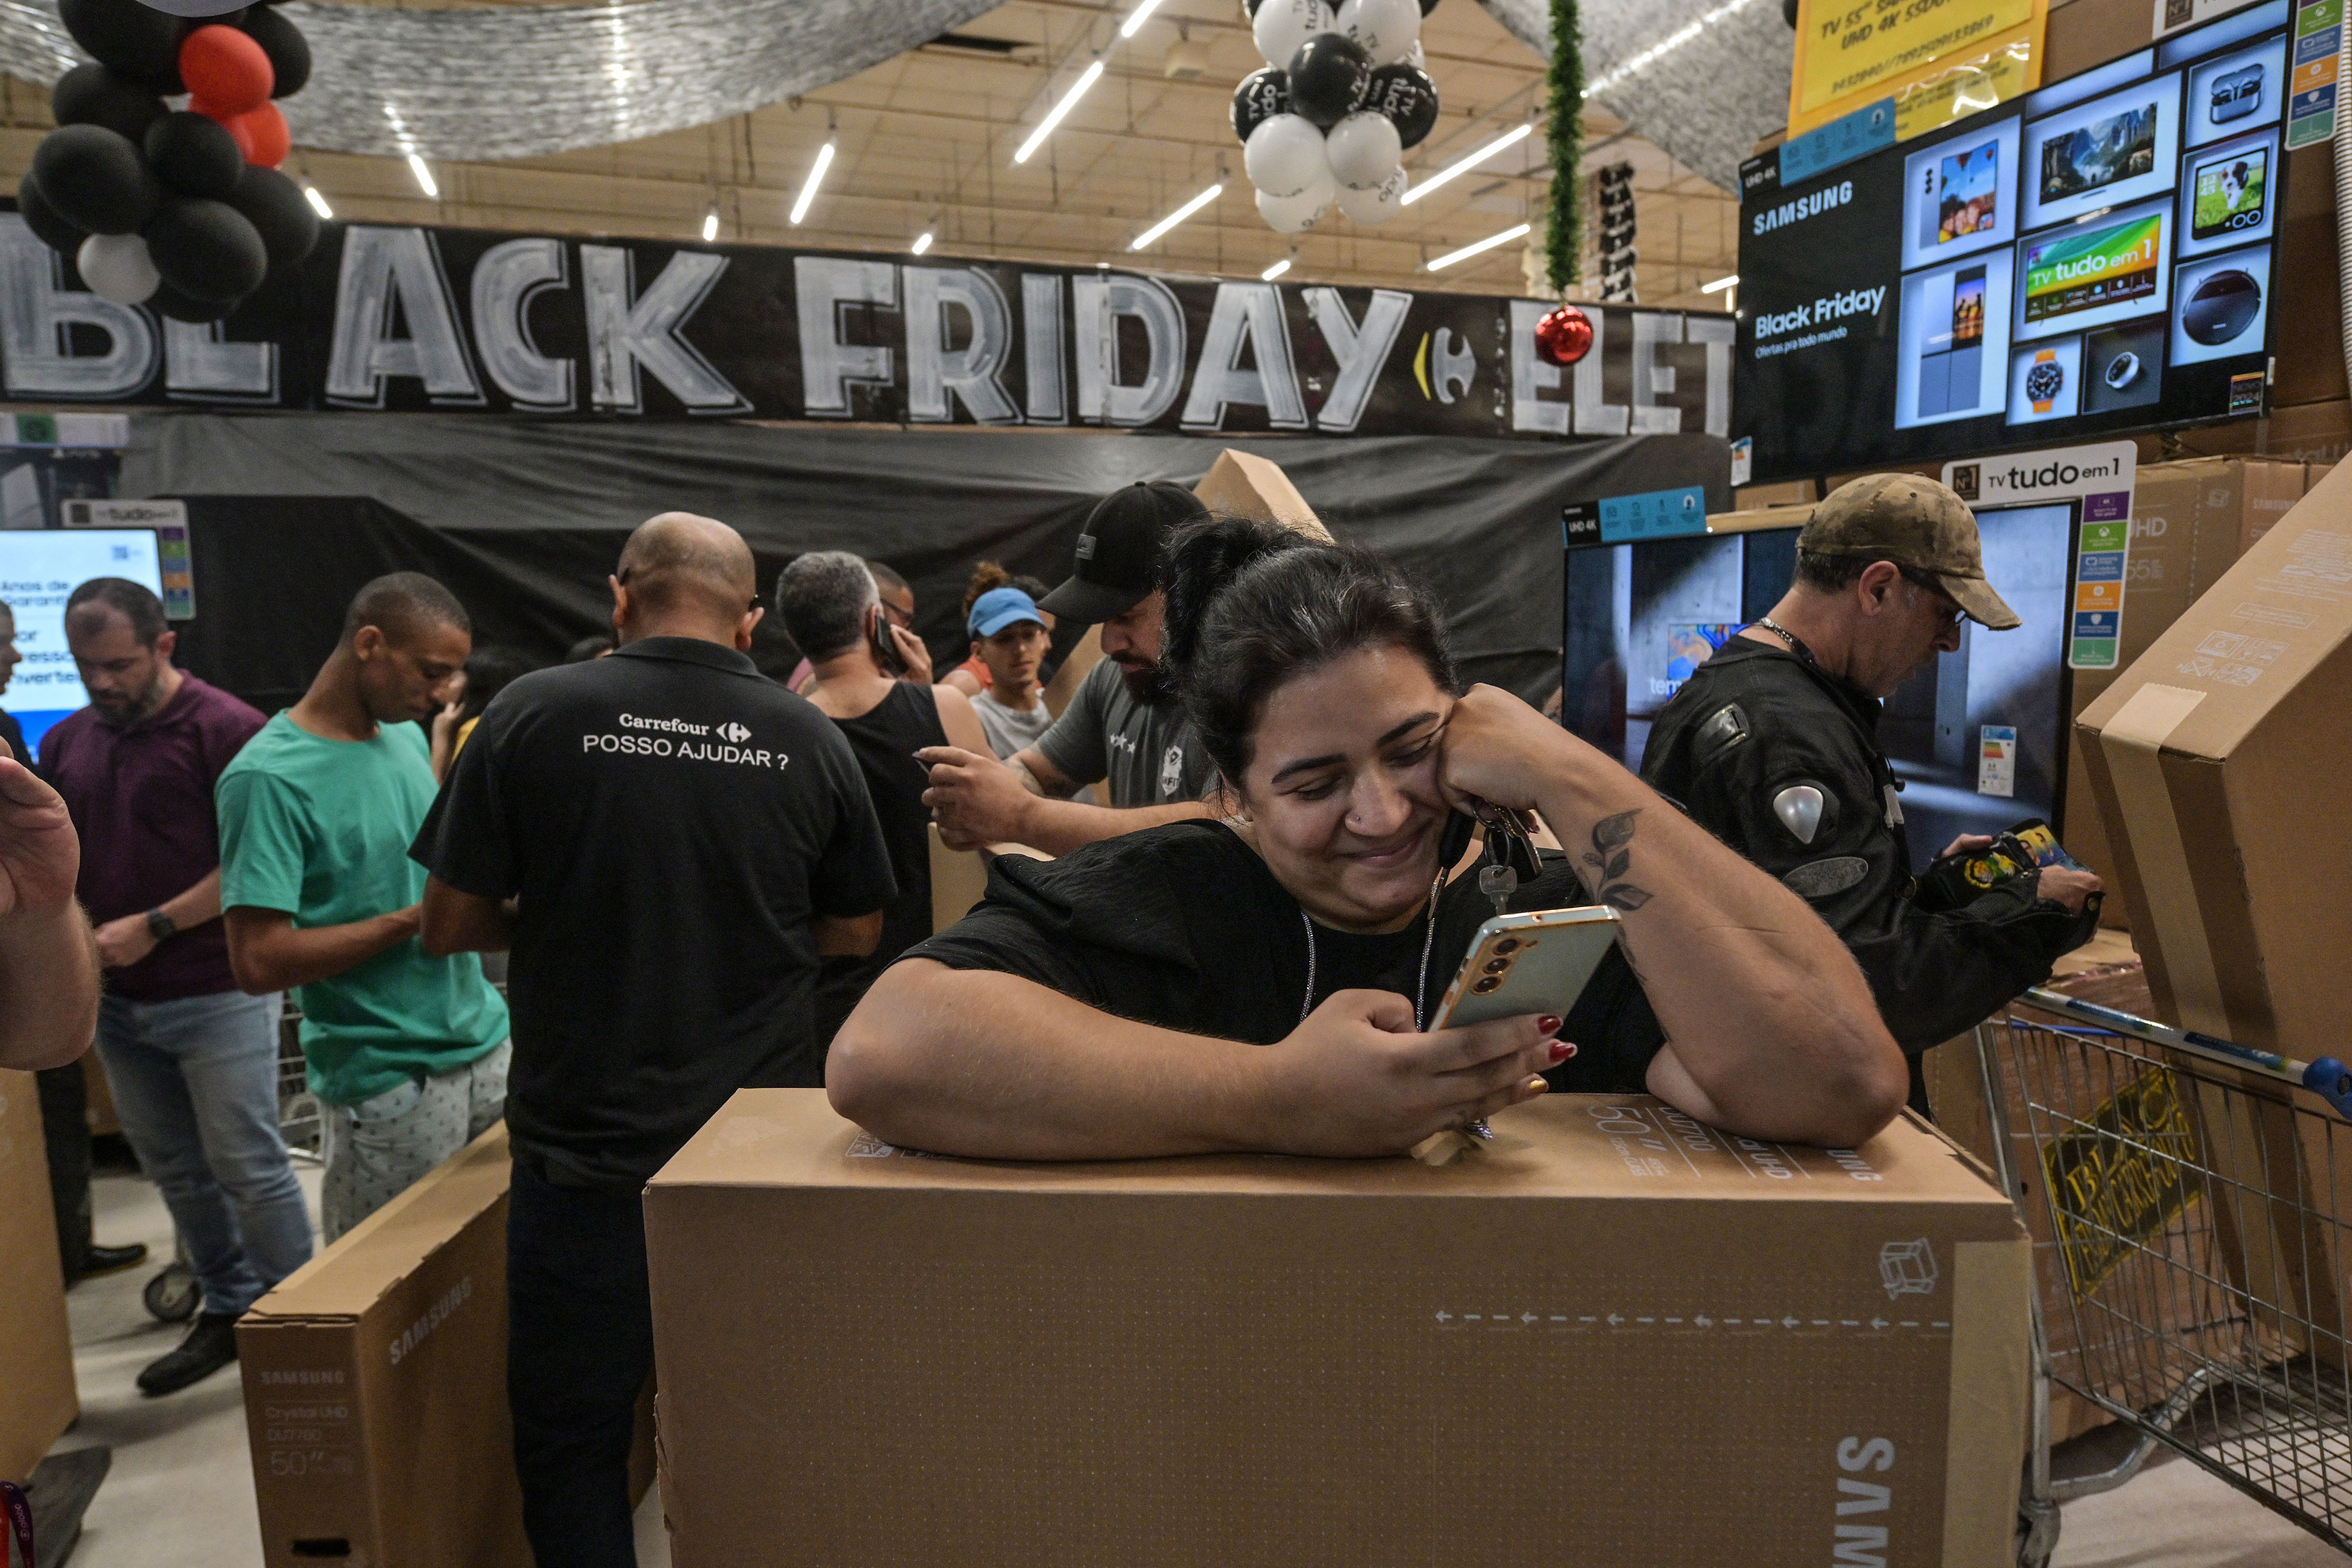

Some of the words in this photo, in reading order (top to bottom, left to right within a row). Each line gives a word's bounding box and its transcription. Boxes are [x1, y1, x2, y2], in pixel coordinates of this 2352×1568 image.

[1753, 181, 1853, 235] SAMSUNG
[2034, 269, 2051, 287] TV
[2055, 255, 2106, 281] tudo
[2110, 250, 2138, 268] em
[2143, 238, 2151, 259] 1
[0, 212, 755, 416] BLACK
[793, 256, 1413, 432] FRIDAY
[1755, 304, 1811, 339] Black
[1814, 286, 1886, 324] Friday
[1755, 341, 1784, 359] Ofertas
[1784, 338, 1798, 356] pra
[1798, 332, 1817, 349] todo
[1818, 326, 1848, 344] mundo
[1988, 475, 2005, 488] TV
[2008, 462, 2079, 490] tudo
[2082, 465, 2108, 478] em
[2112, 457, 2119, 475] 1
[1569, 519, 1586, 533] UHD
[1586, 517, 1597, 532] 4K
[619, 713, 709, 736] Carrefour
[583, 734, 672, 757] POSSO
[677, 741, 771, 767] AJUDAR
[390, 1275, 471, 1365] SAMSUNG
[261, 1370, 345, 1385] SAMSUNG
[14, 1503, 27, 1528] globo
